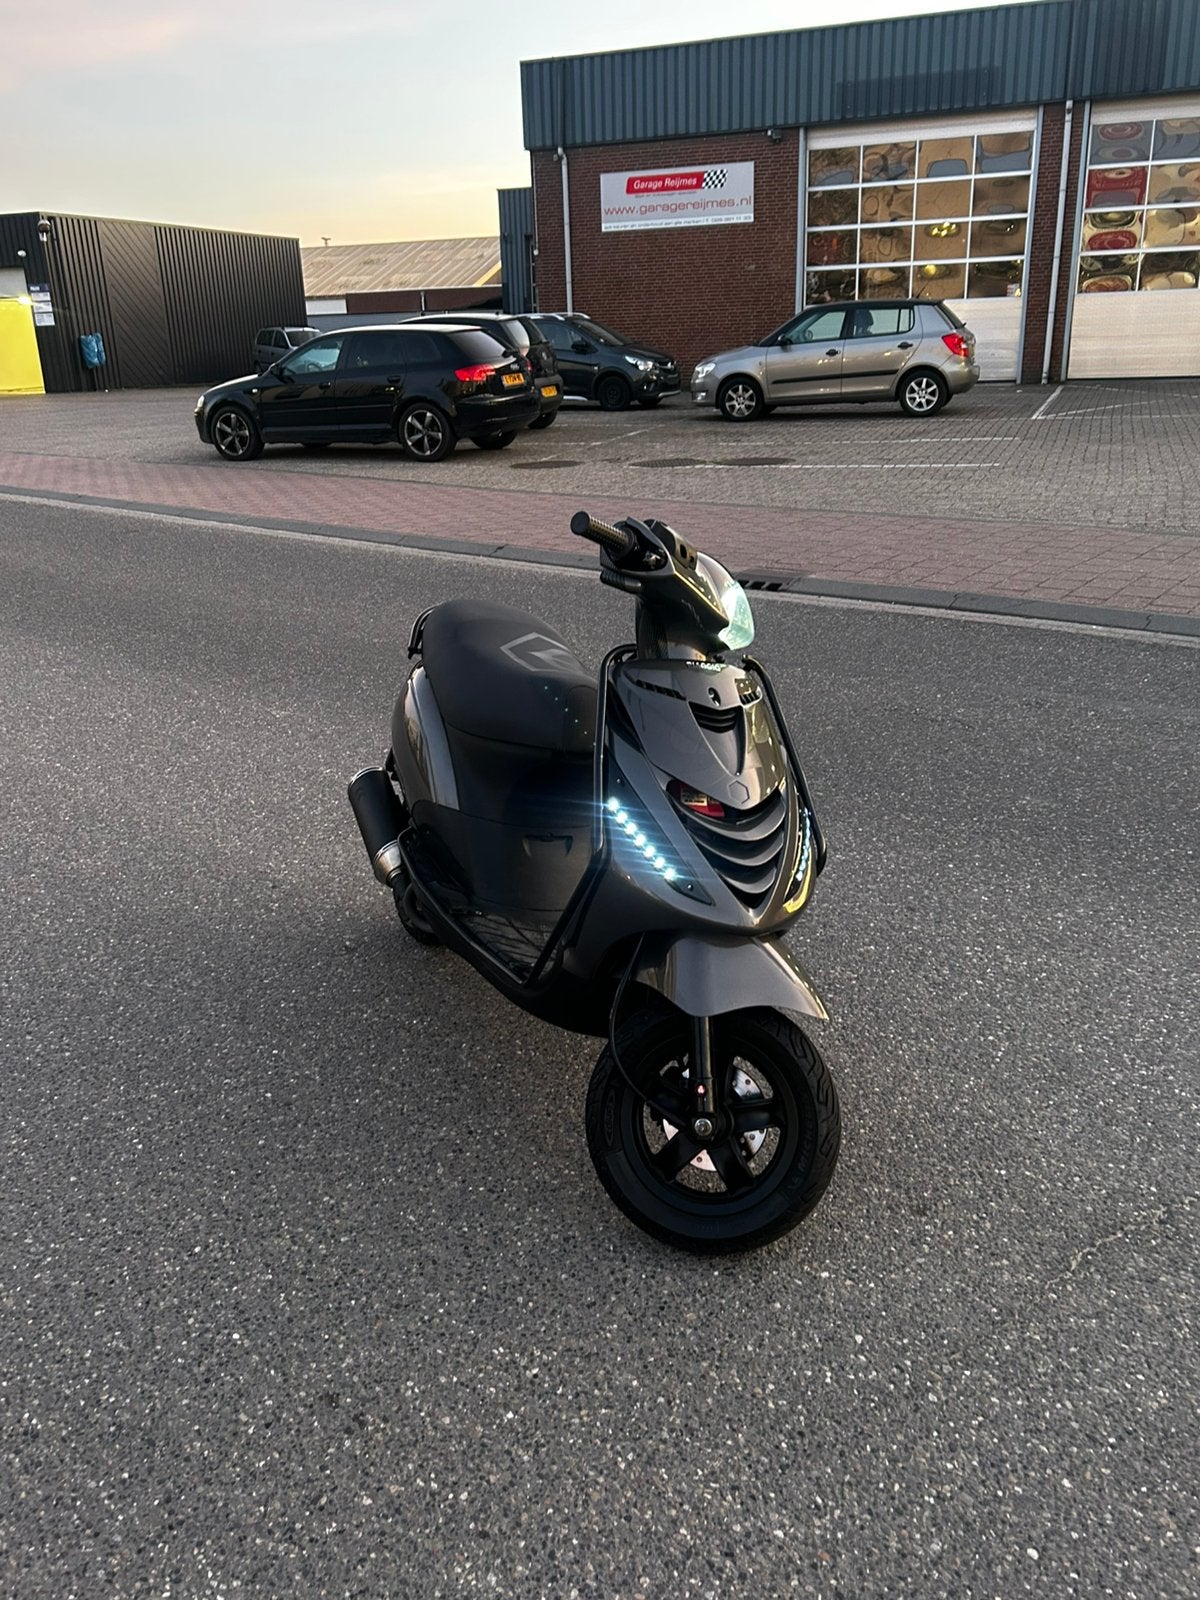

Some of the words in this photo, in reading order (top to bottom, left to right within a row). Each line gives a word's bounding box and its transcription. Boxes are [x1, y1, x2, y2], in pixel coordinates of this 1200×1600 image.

[633, 179, 662, 190] Garage
[664, 177, 697, 188] Reijmes
[604, 195, 751, 215] www.garagereijmes.nl
